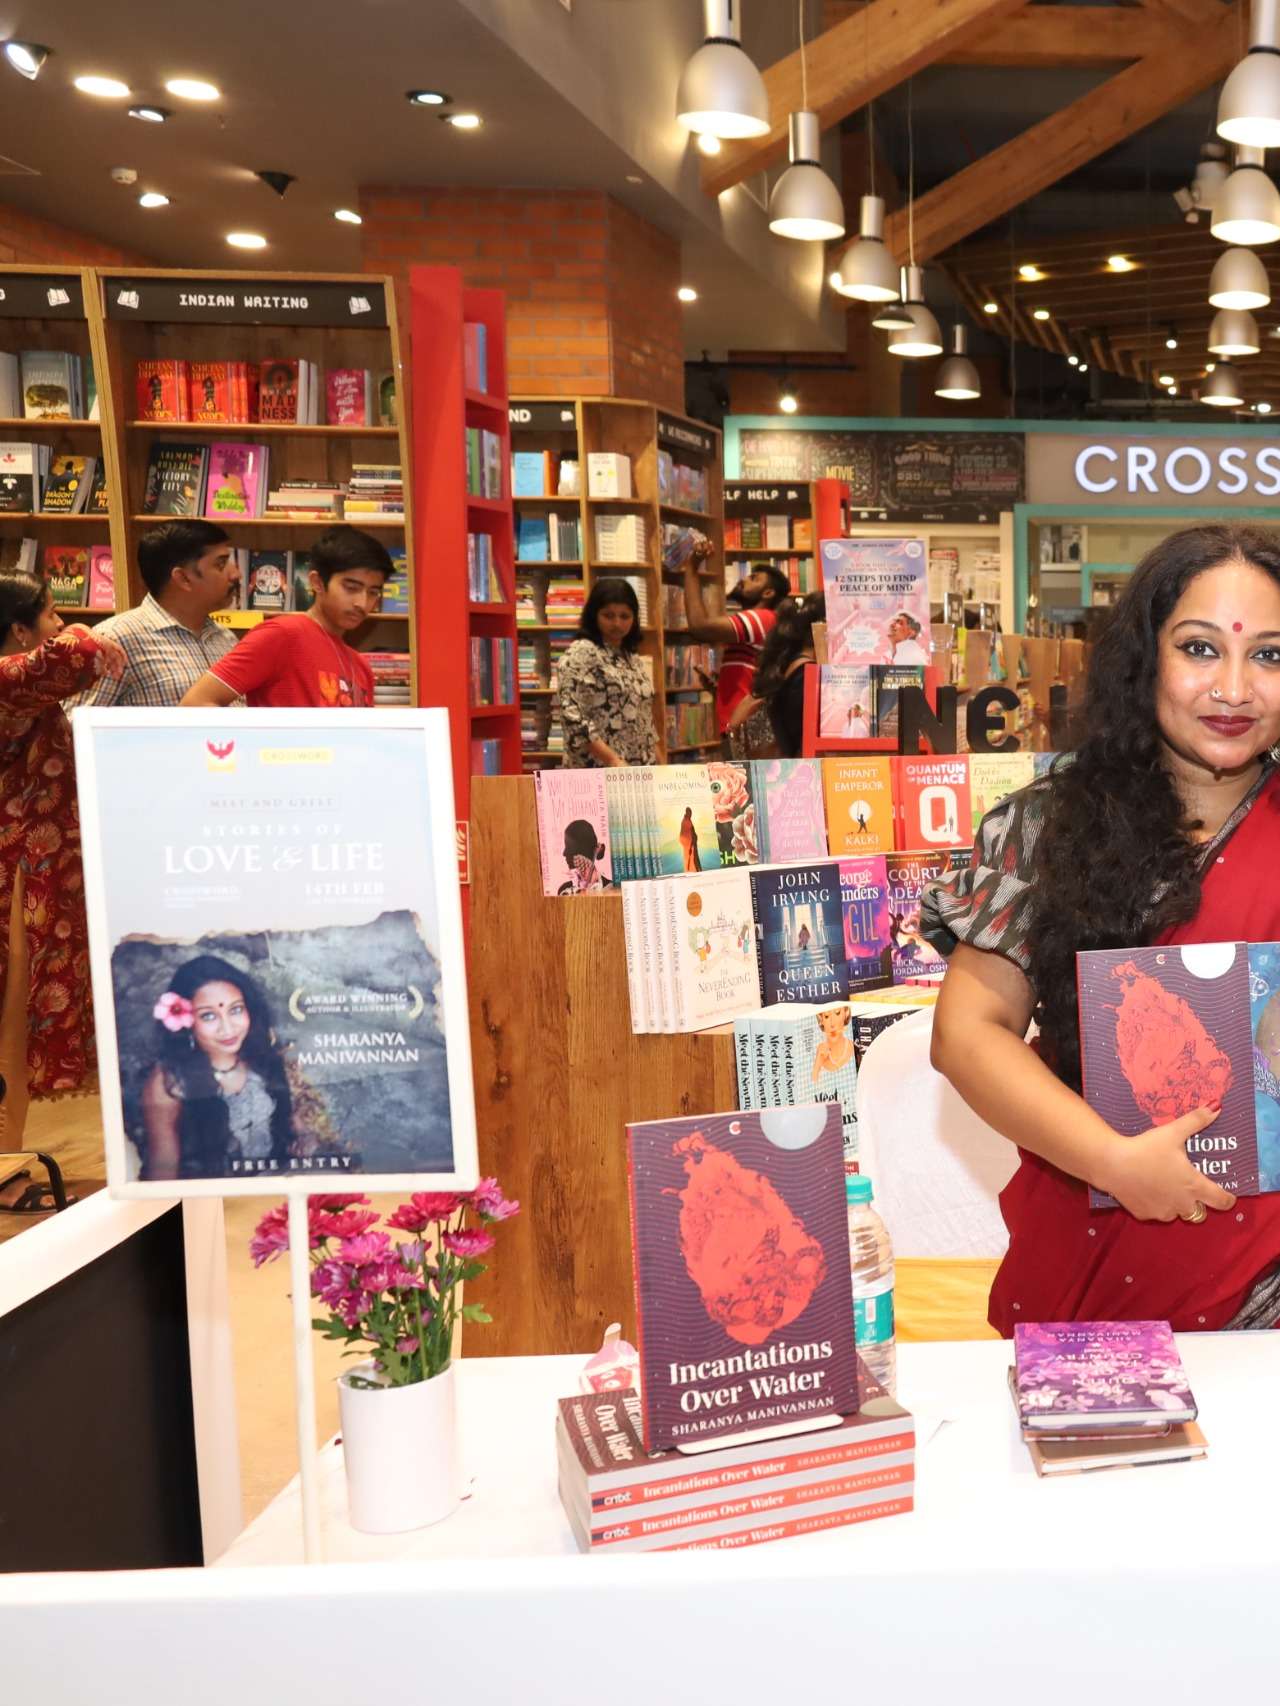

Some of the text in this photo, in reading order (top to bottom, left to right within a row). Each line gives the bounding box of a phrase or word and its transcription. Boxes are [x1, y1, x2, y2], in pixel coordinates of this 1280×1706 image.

[179, 294, 309, 309] INDIAN WRITING
[262, 397, 296, 407] MAD
[262, 408, 296, 419] NESS
[156, 472, 191, 482] VICTORY
[162, 482, 182, 492] CITY
[747, 489, 779, 501] HELP
[50, 577, 77, 585] NAGA
[835, 574, 917, 583] 12 STEPS TO FIND
[839, 583, 913, 592] PEACE OF MIND
[839, 767, 878, 779] INFANT
[906, 764, 966, 777] QUANTUM
[916, 774, 966, 785] MENACE
[834, 781, 885, 793] EMPEROR
[918, 785, 963, 845] Q
[201, 824, 343, 837] STORIES OF
[844, 835, 880, 847] KALKI
[163, 845, 262, 874] LOVE
[311, 842, 385, 872] LIFE
[907, 862, 919, 870] THE
[777, 871, 821, 890] JOHN
[839, 868, 873, 887] eorge
[888, 865, 941, 882] COURT
[351, 881, 385, 896] FEB
[911, 878, 925, 887] THE
[895, 881, 923, 899] DEA
[771, 889, 831, 908] IRVING
[778, 963, 835, 985] QUEEN
[304, 991, 409, 1005] AWARD WINNING
[715, 987, 736, 1001] BOOK
[776, 979, 842, 1003] ESTHER
[313, 1031, 406, 1048] SHARANYA
[298, 1048, 420, 1066] MANIVANNAN
[232, 1157, 353, 1171] FREE ENTRY
[668, 1339, 834, 1386] Incantations
[679, 1370, 827, 1414] Over Water
[671, 1395, 836, 1437] SHARANYA MANIVANNAN
[642, 1460, 788, 1499] Incantations Over Water
